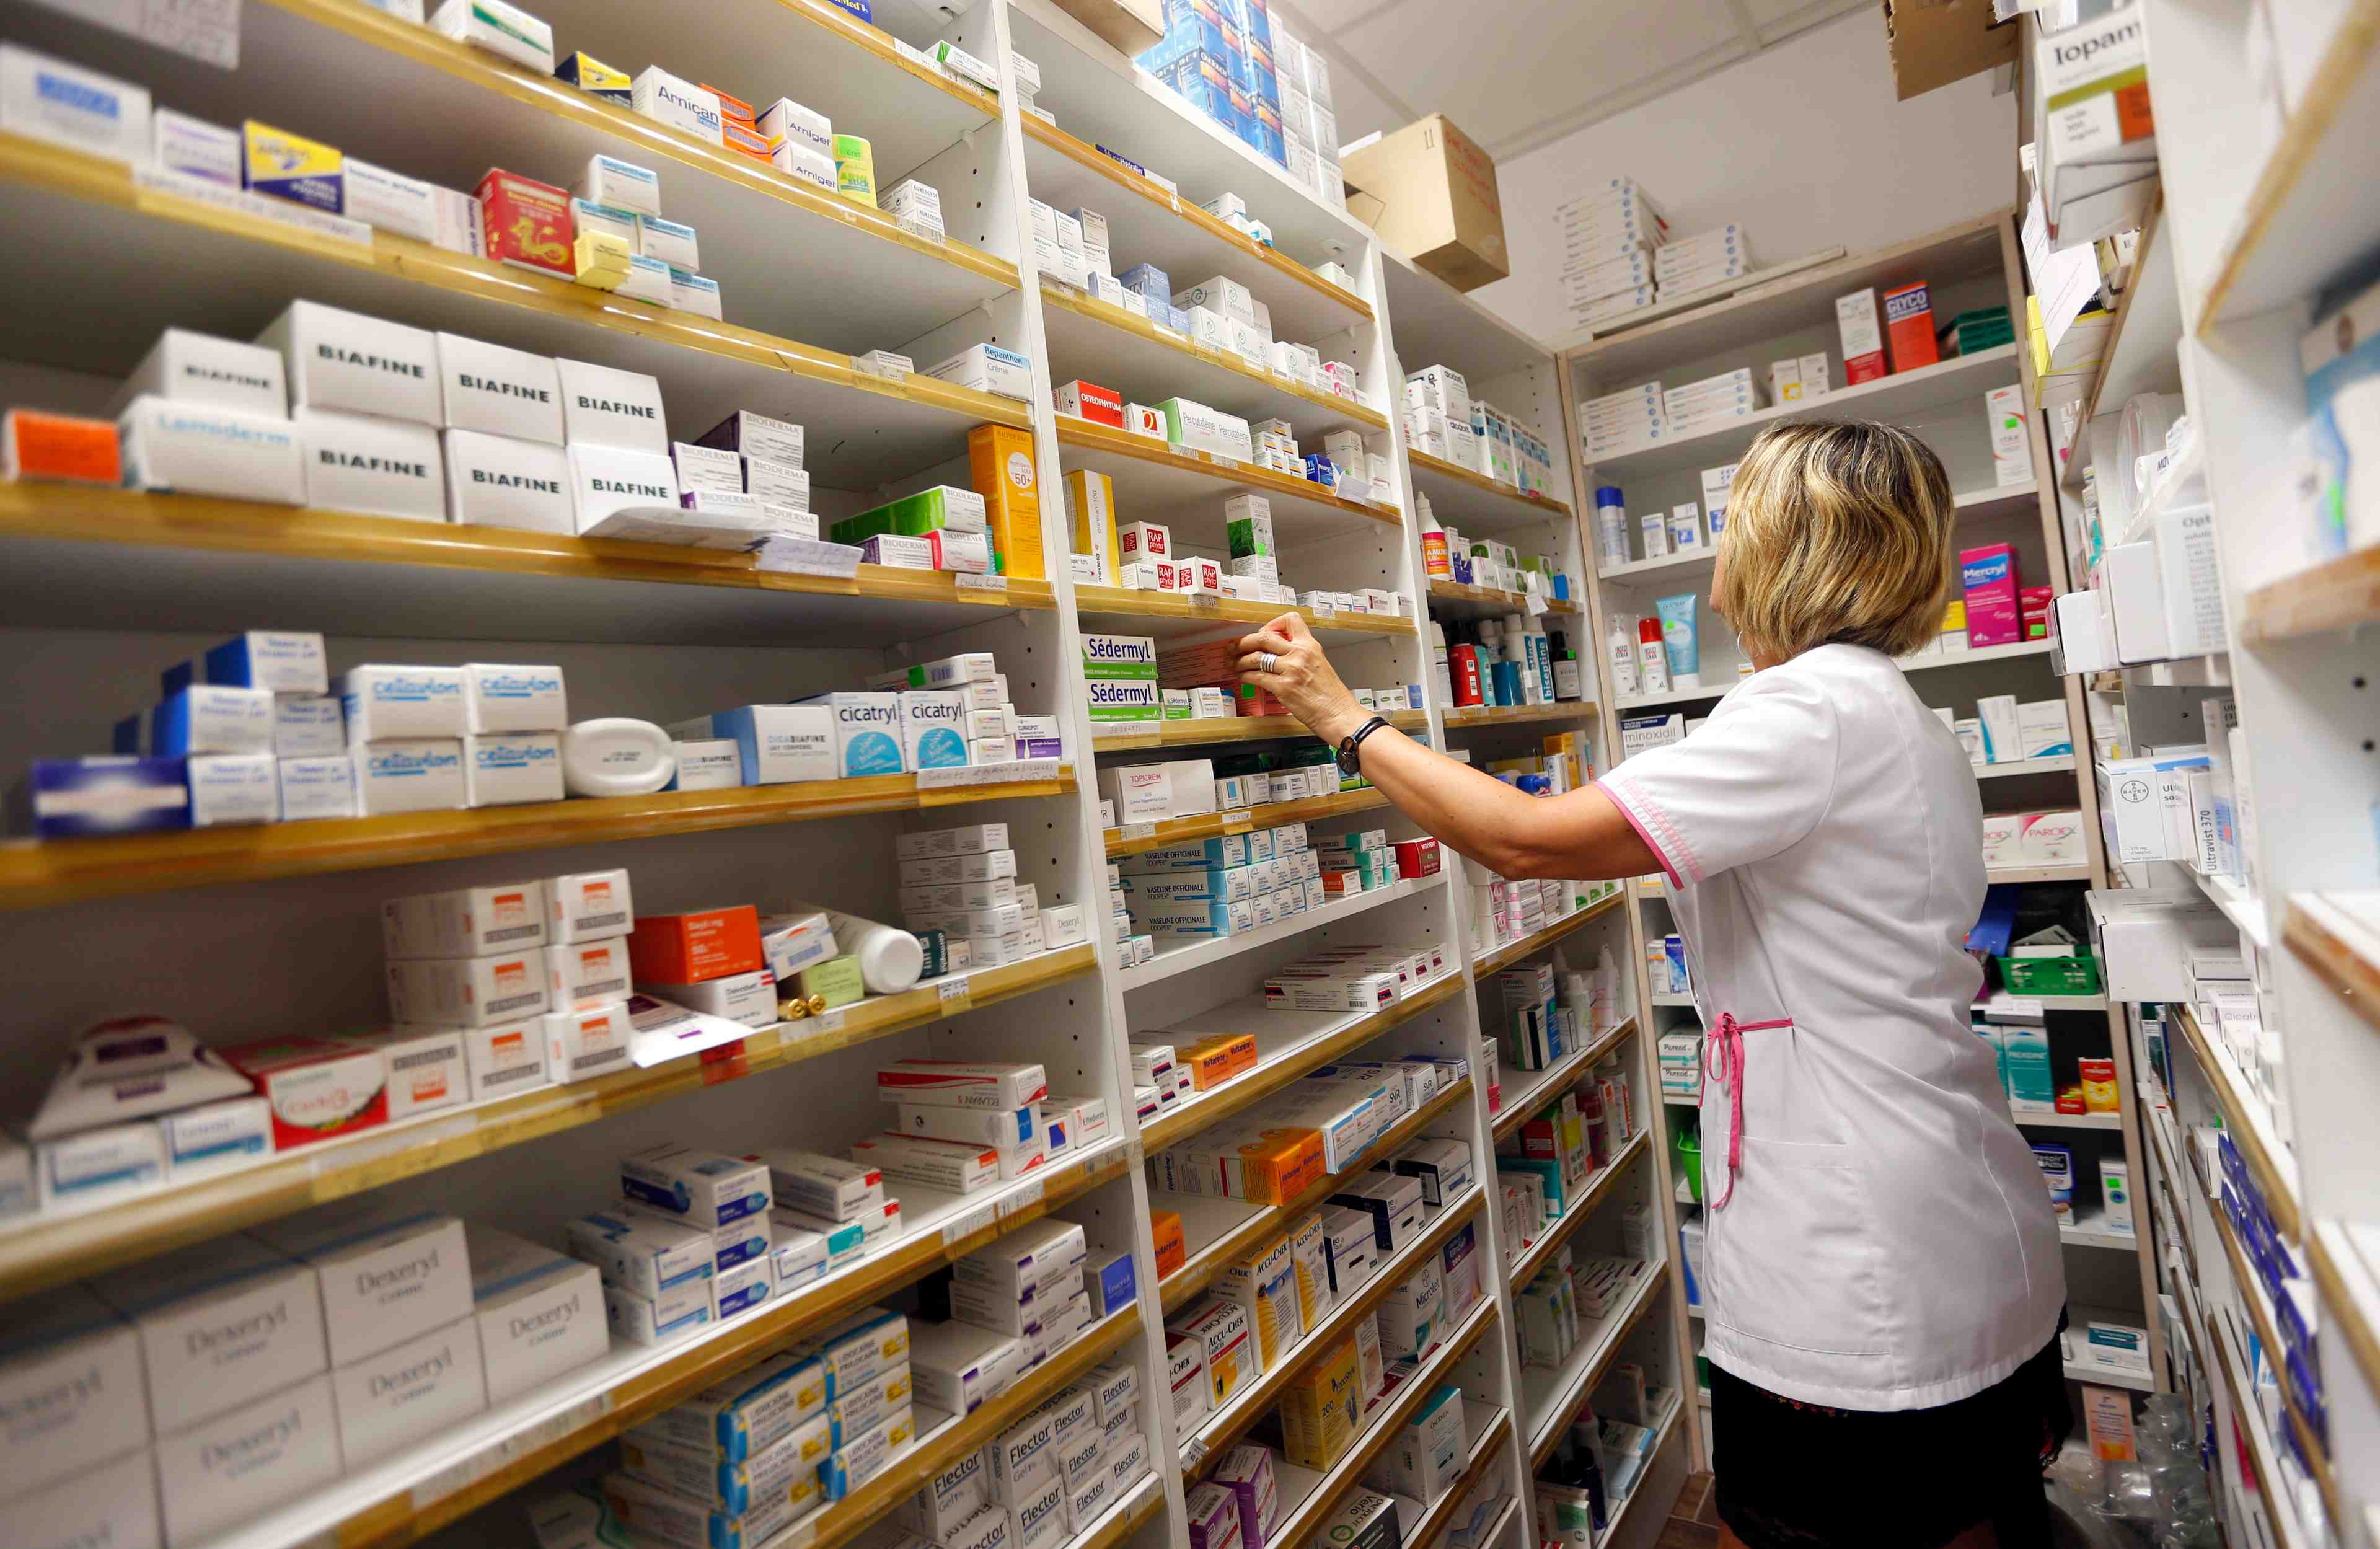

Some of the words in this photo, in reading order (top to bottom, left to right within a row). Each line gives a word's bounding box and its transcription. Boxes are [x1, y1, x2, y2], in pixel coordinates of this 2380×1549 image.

[658, 85, 719, 123] Arnican
[726, 126, 767, 150] Arnican
[790, 122, 831, 146] Arnigel
[796, 165, 835, 188] Arnigel
[318, 344, 425, 379] BIAFINE
[984, 346, 1023, 364] Bepanthen
[184, 366, 271, 389] BIAFINE
[987, 363, 1009, 375] Crème
[459, 374, 550, 404] BIAFINE
[578, 396, 655, 420] BIAFINE
[1081, 392, 1121, 412] OSTEOPHYTUM
[745, 413, 800, 434] BIODERMA
[320, 449, 426, 477] BIAFINE
[682, 446, 736, 462] BIODERMA
[753, 460, 806, 481] BIODERMA
[1014, 472, 1031, 485] 50+
[472, 469, 560, 494] BIAFINE
[592, 479, 669, 498] BIAFINE
[946, 489, 982, 503] BIODERMA
[763, 505, 815, 524] BIODERMA
[883, 539, 929, 551] BIODERMA
[943, 532, 984, 542] BIODERMA
[1148, 531, 1163, 542] RAP
[1150, 541, 1163, 550] phyto
[1158, 567, 1173, 577] RAP
[1160, 576, 1174, 585] phyto
[1203, 566, 1216, 577] RAP
[1204, 576, 1217, 586] phyto
[1089, 638, 1150, 663] Sédermyl
[1539, 642, 1553, 698] biseptine
[1090, 683, 1153, 705] Sédermyl
[840, 704, 897, 725] cicatryl
[912, 702, 962, 722] cicatryl
[1625, 728, 1676, 742] minoxidil
[1130, 773, 1161, 783] TOPICREM
[2200, 810, 2212, 827] 370
[1983, 829, 2013, 844] ROEX
[2029, 825, 2076, 841] PAROEX
[1170, 850, 1200, 858] OFFICINALE
[2204, 829, 2217, 871] Ultravist
[1147, 885, 1171, 893] VASELINE
[1172, 884, 1204, 892] OFFICINALE
[1058, 917, 1079, 929] Dexeryl
[1230, 1041, 1251, 1055] Voltarène
[1204, 1053, 1225, 1069] Voltarène
[1389, 1089, 1401, 1104] SVR
[1423, 1080, 1434, 1092] SVR
[1296, 1223, 1320, 1249] ACCU-CHEK
[1256, 1243, 1287, 1276] ACCU-CHEK
[357, 1249, 440, 1295] Dexeryl
[1416, 1278, 1439, 1308] Microlet
[509, 1294, 579, 1339] Dexeryl
[186, 1303, 287, 1355] Dexeryl
[1209, 1317, 1245, 1348] ACCU-CHEK
[369, 1346, 453, 1397] Dexeryl
[1170, 1356, 1192, 1377] -CHEK
[1103, 1375, 1130, 1402] Flector
[1054, 1403, 1085, 1431] Flector
[1322, 1401, 1334, 1416] 200
[199, 1410, 301, 1469] Dexeryl
[1010, 1425, 1051, 1463] Flector
[1069, 1442, 1098, 1472] Flector
[1114, 1446, 1140, 1475] Flector
[935, 1452, 979, 1494] Flector
[1077, 1480, 1104, 1511] Flector
[1021, 1486, 1061, 1527] Flector
[967, 1520, 1005, 1549] lector
